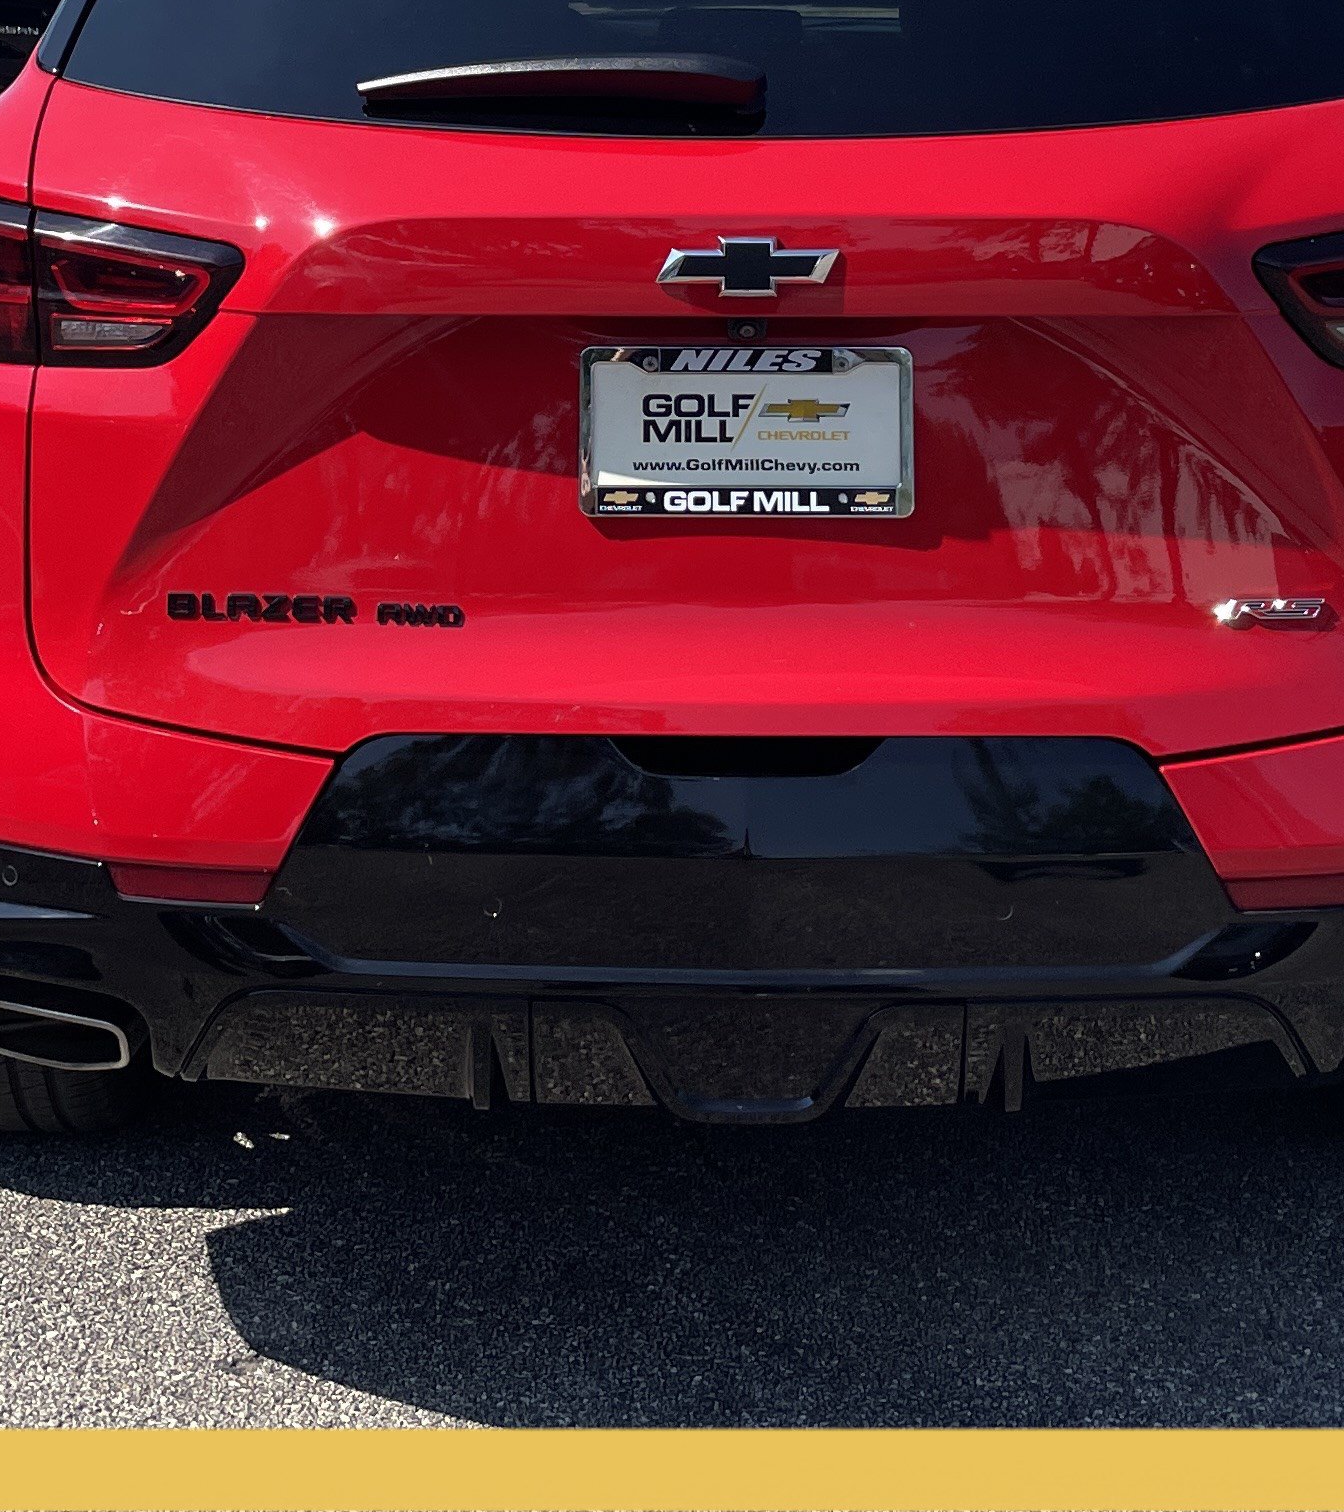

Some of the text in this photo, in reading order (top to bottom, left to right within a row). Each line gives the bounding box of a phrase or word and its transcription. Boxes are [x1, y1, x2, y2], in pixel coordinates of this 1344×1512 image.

[670, 349, 822, 371] NILES
[642, 393, 756, 418] GOLF
[642, 419, 735, 443] MILL
[757, 430, 850, 441] CHEVROLET
[632, 458, 860, 473] www.GolfMillChevy.com
[663, 491, 830, 512] GOLF MILL
[167, 592, 465, 627] BLAZER AWD
[1213, 598, 1326, 622] RS
